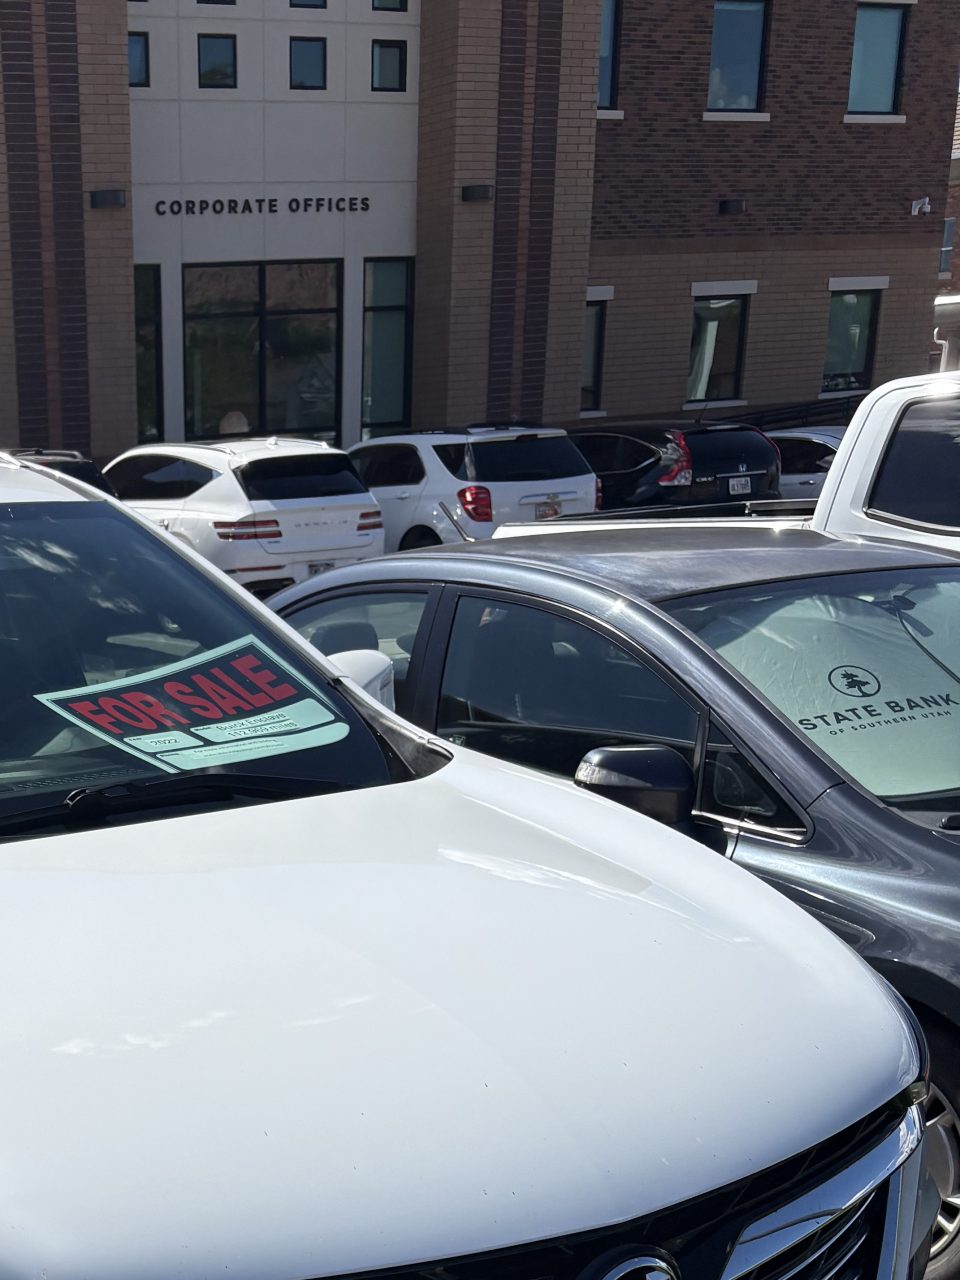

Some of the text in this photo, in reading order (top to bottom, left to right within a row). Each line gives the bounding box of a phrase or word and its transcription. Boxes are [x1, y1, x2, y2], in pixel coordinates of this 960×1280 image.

[155, 197, 370, 216] CORPORATE OFFICES
[68, 654, 298, 734] FOR SALE
[798, 693, 960, 731] STATE BANK
[851, 715, 917, 731] SOUTHERN
[920, 710, 952, 719] UTAH
[216, 721, 245, 731] Buick
